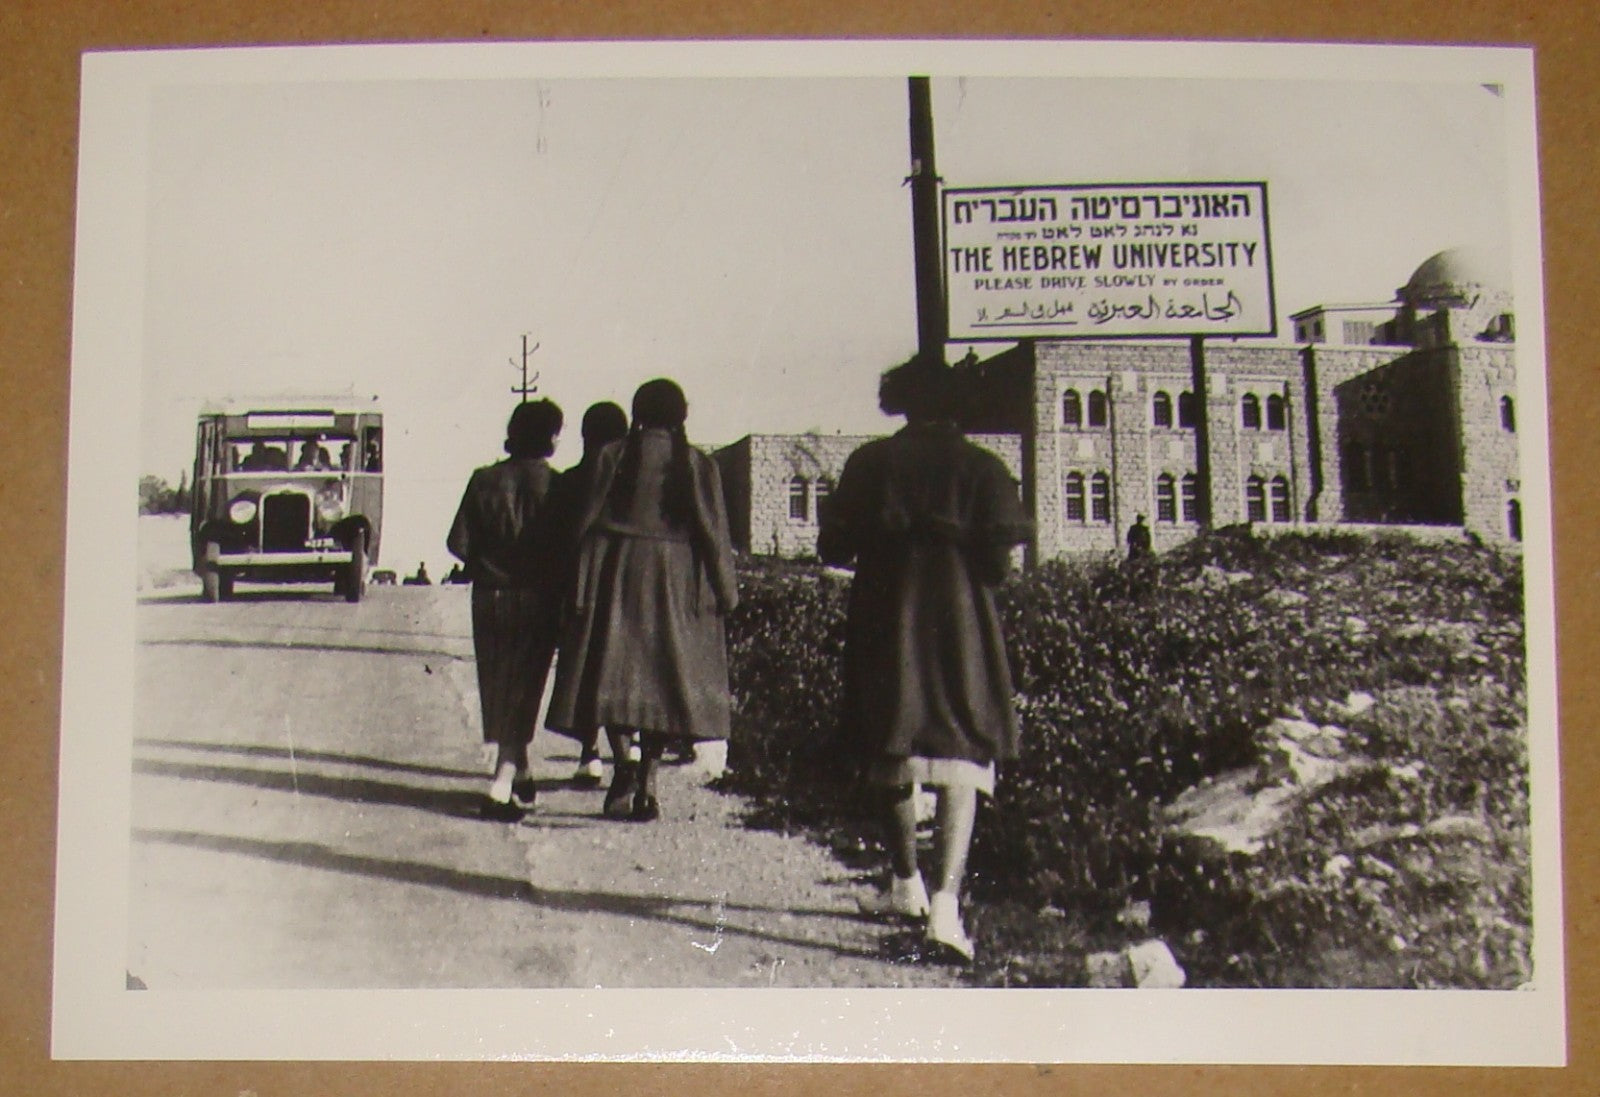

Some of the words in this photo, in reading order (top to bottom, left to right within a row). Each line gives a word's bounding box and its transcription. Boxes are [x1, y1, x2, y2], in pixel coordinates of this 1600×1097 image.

[953, 198, 1059, 225] העברית
[1070, 194, 1252, 223] האוניברסיטה
[1041, 223, 1083, 240] לאט
[1089, 223, 1128, 239] לאט
[1180, 223, 1199, 237] נא
[949, 245, 994, 274] THE
[1002, 244, 1103, 272] HEBREW
[1112, 241, 1258, 270] UNIVERSITY
[974, 277, 1033, 291] PLEASE
[1040, 276, 1087, 291] DRIVE
[1093, 274, 1156, 288] SLOWLY
[1162, 278, 1178, 287] BY
[1182, 277, 1225, 287] ORDER
[1164, 289, 1243, 323] الجامعة
